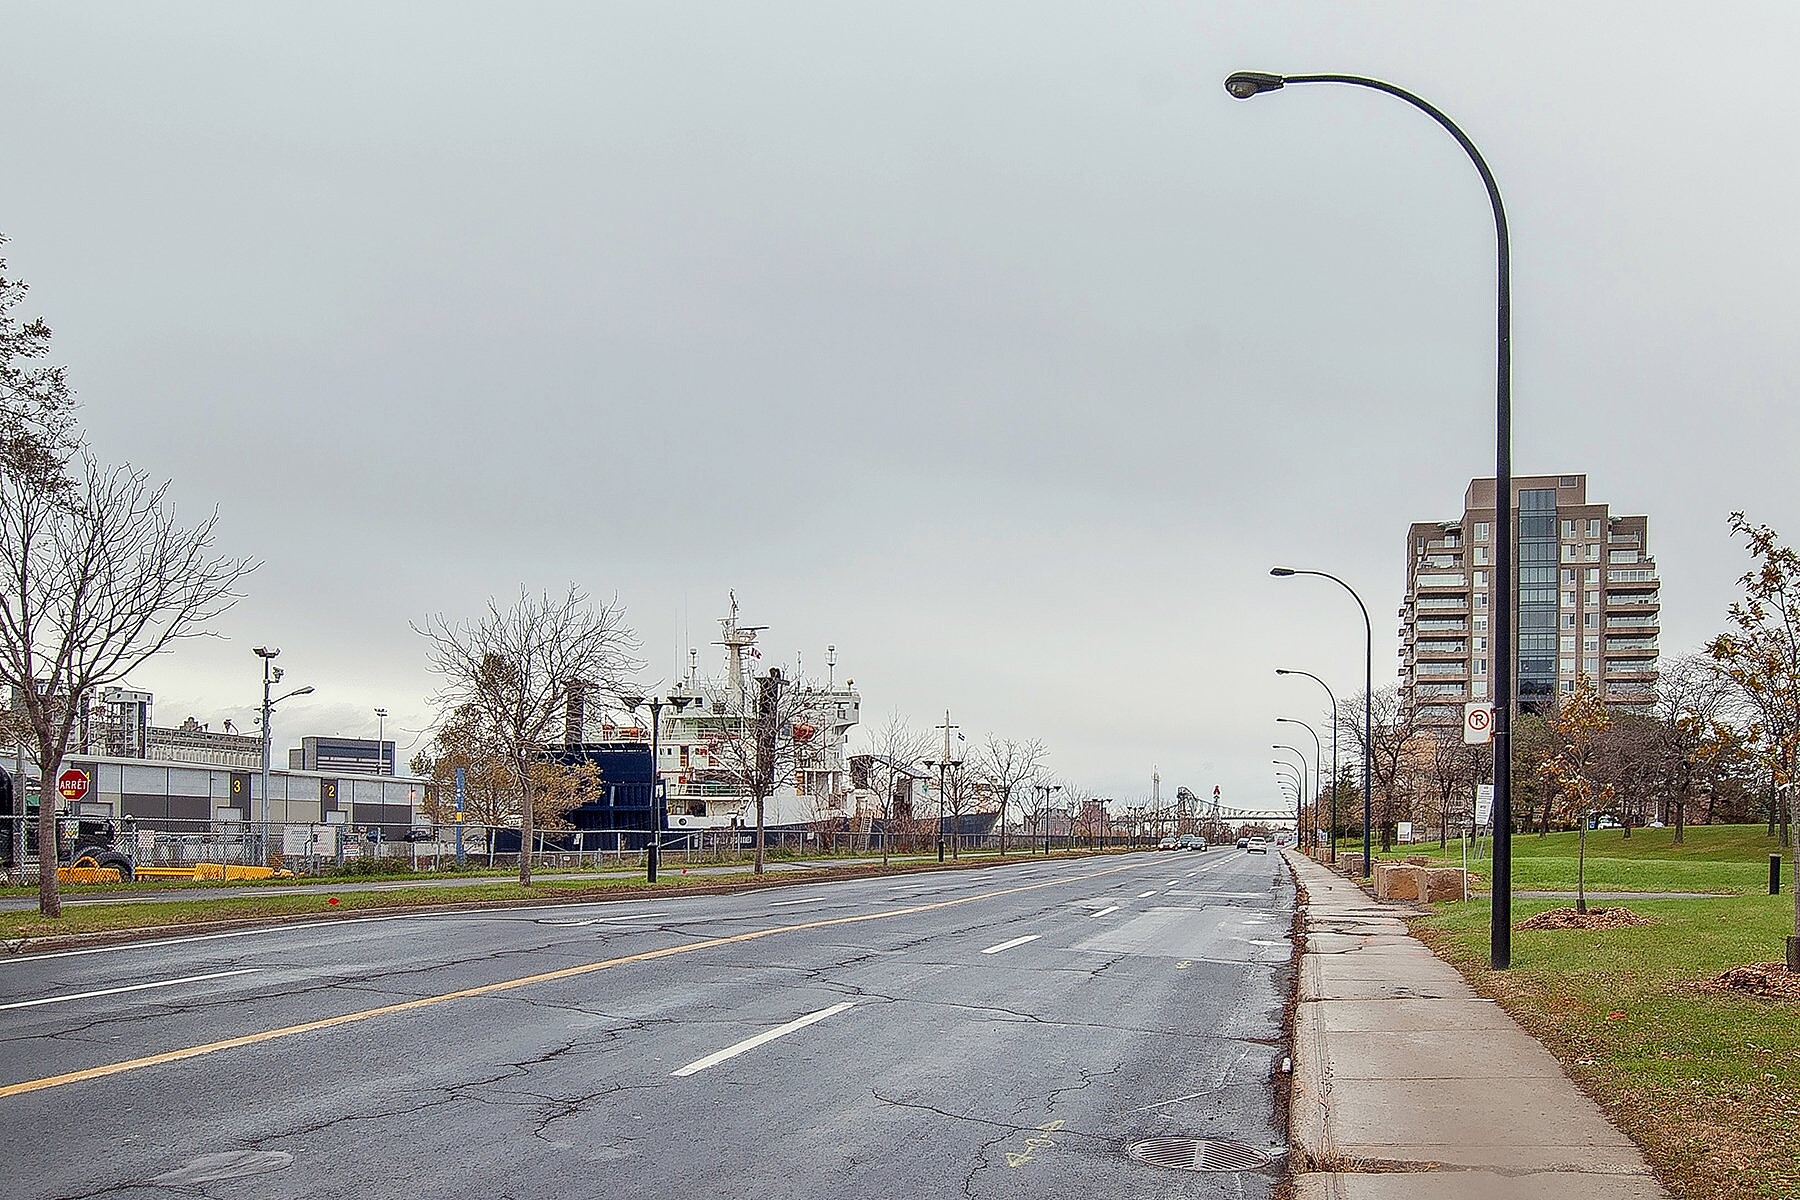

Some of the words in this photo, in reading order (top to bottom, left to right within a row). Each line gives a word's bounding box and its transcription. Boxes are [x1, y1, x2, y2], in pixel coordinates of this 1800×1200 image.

[60, 779, 86, 789] ARRÊT
[234, 780, 240, 792] 3
[328, 786, 335, 797] 2
